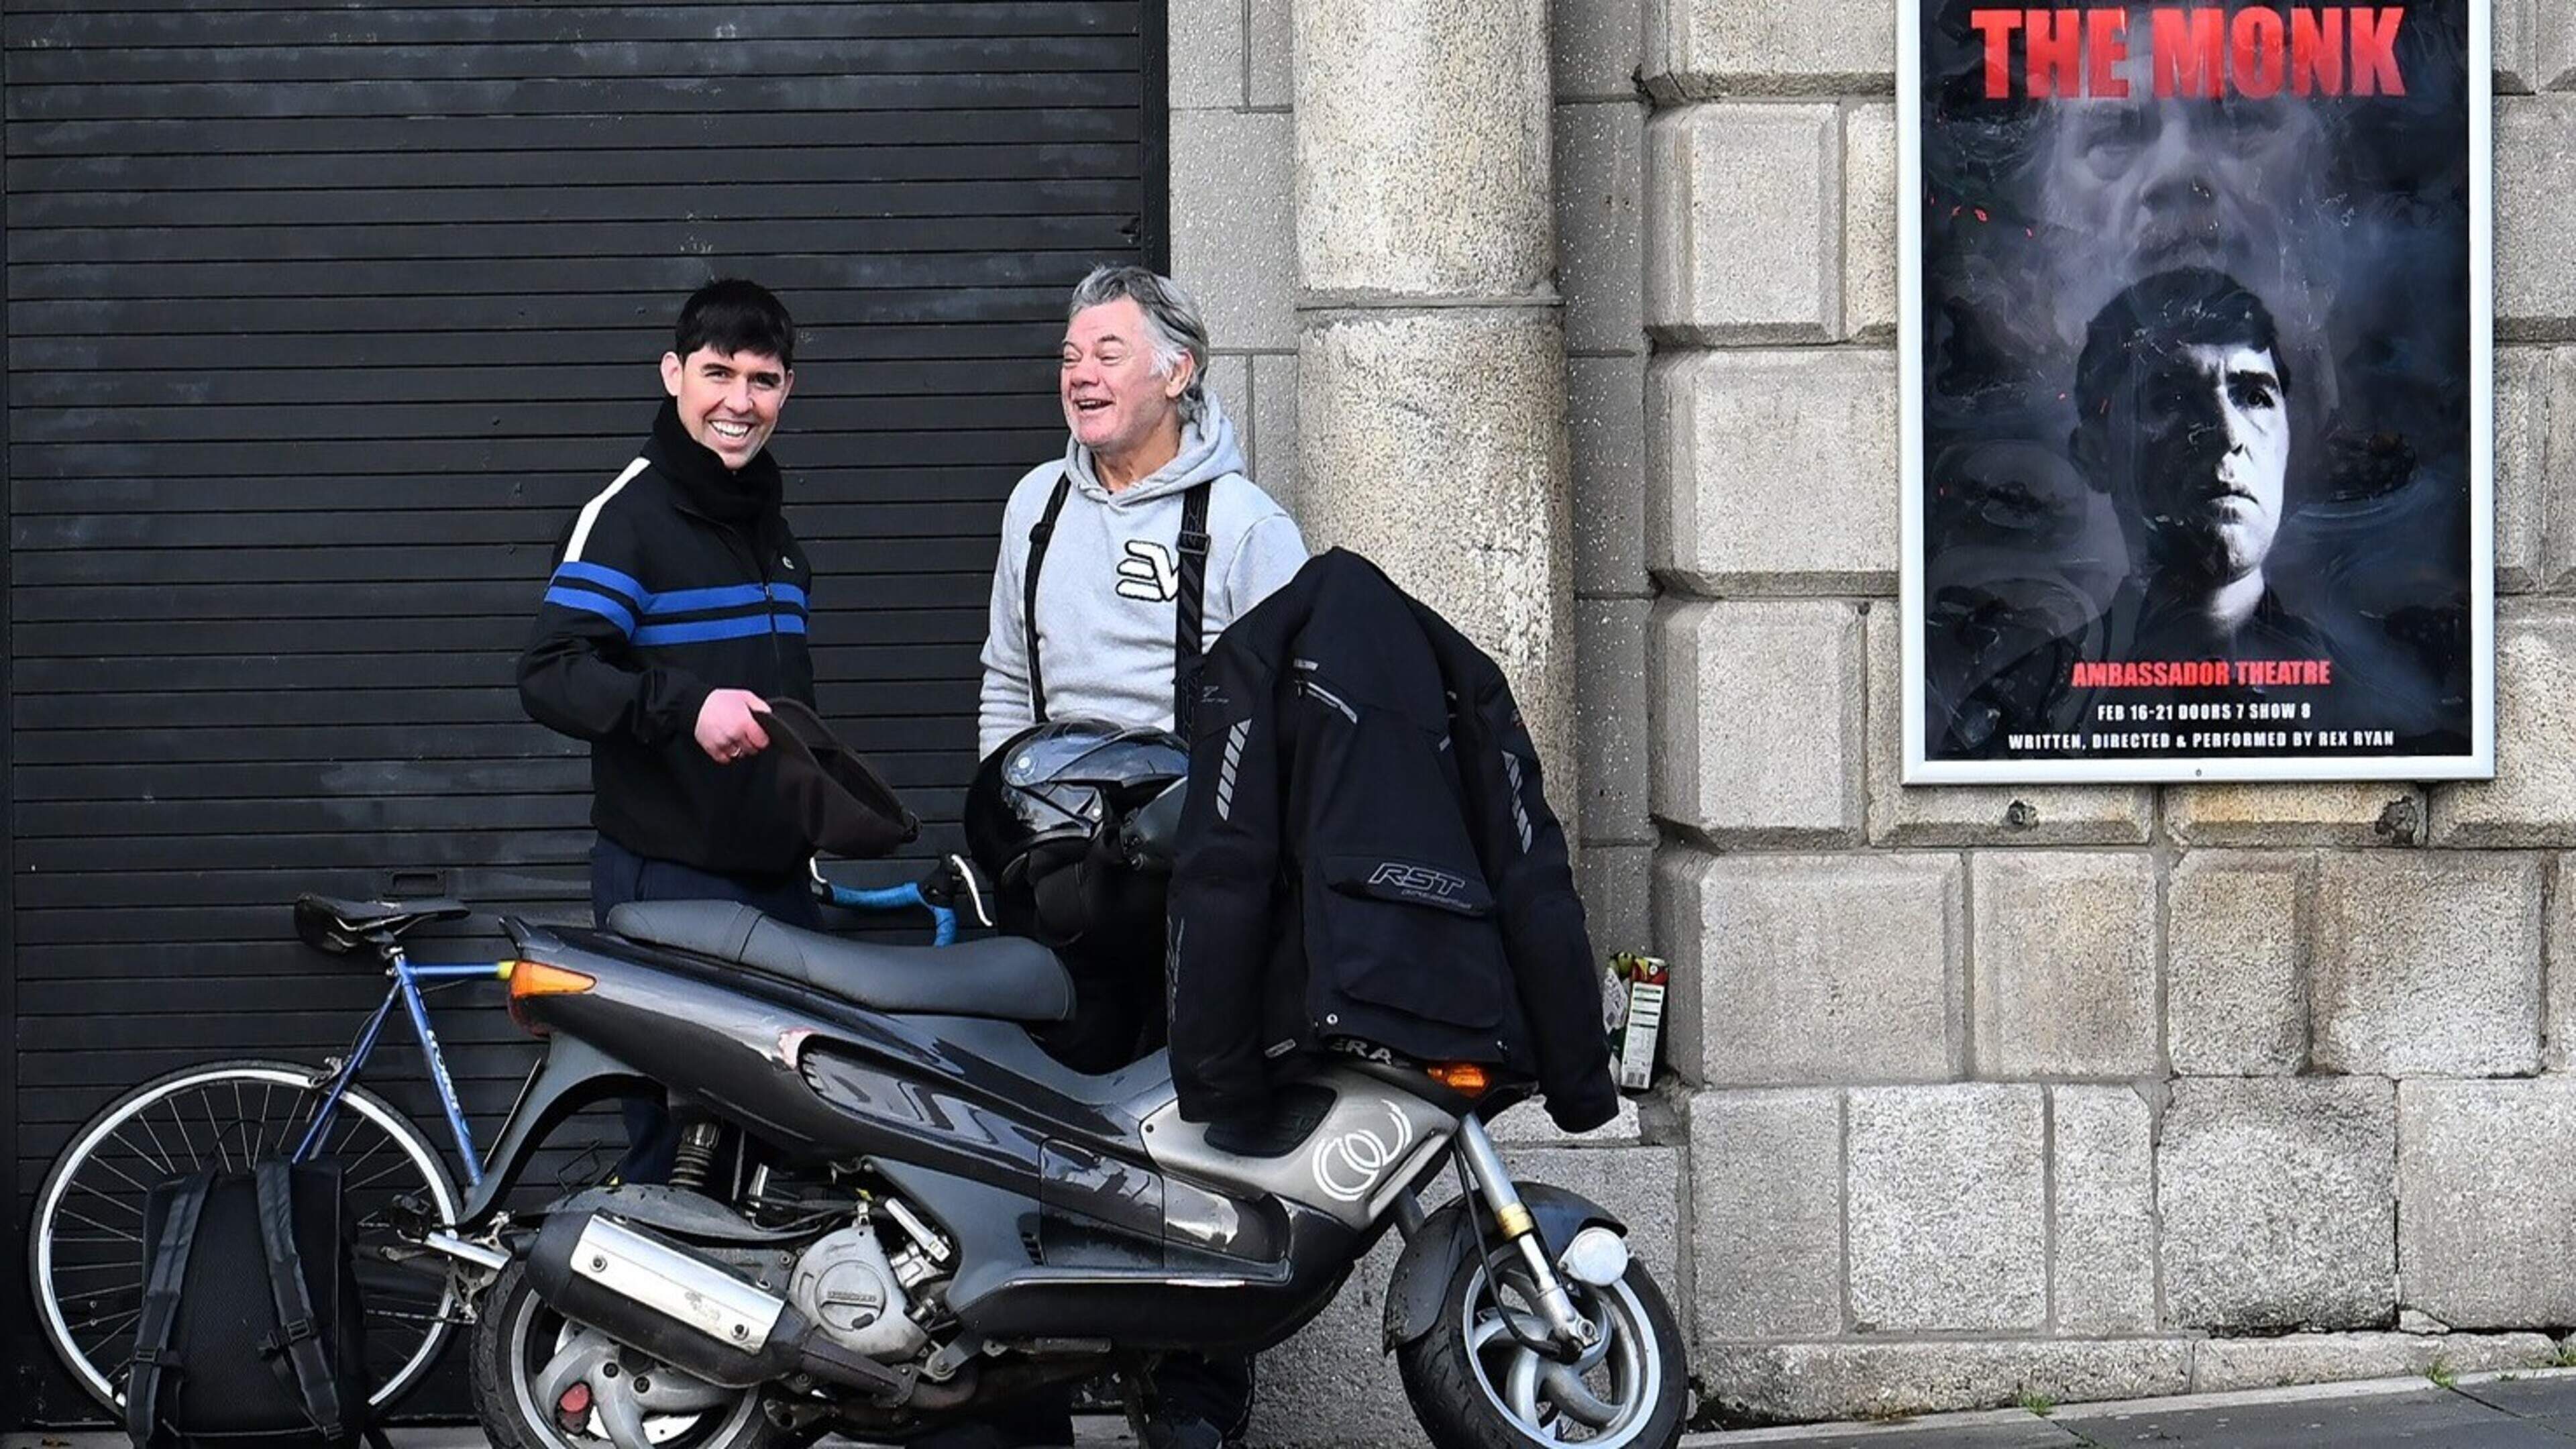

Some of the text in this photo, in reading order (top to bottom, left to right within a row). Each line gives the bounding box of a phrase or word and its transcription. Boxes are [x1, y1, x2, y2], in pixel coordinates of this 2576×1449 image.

[1970, 5, 2407, 99] THE MONK
[2071, 660, 2331, 687] AMBASSADOR THEATRE
[2097, 702, 2312, 721] FEB 16-21 DOORS 7 SHOW 8
[2008, 730, 2394, 751] WRITTEN, DIRECTED & PERFORMED BY REX RYAN
[1368, 862, 1466, 896] RST
